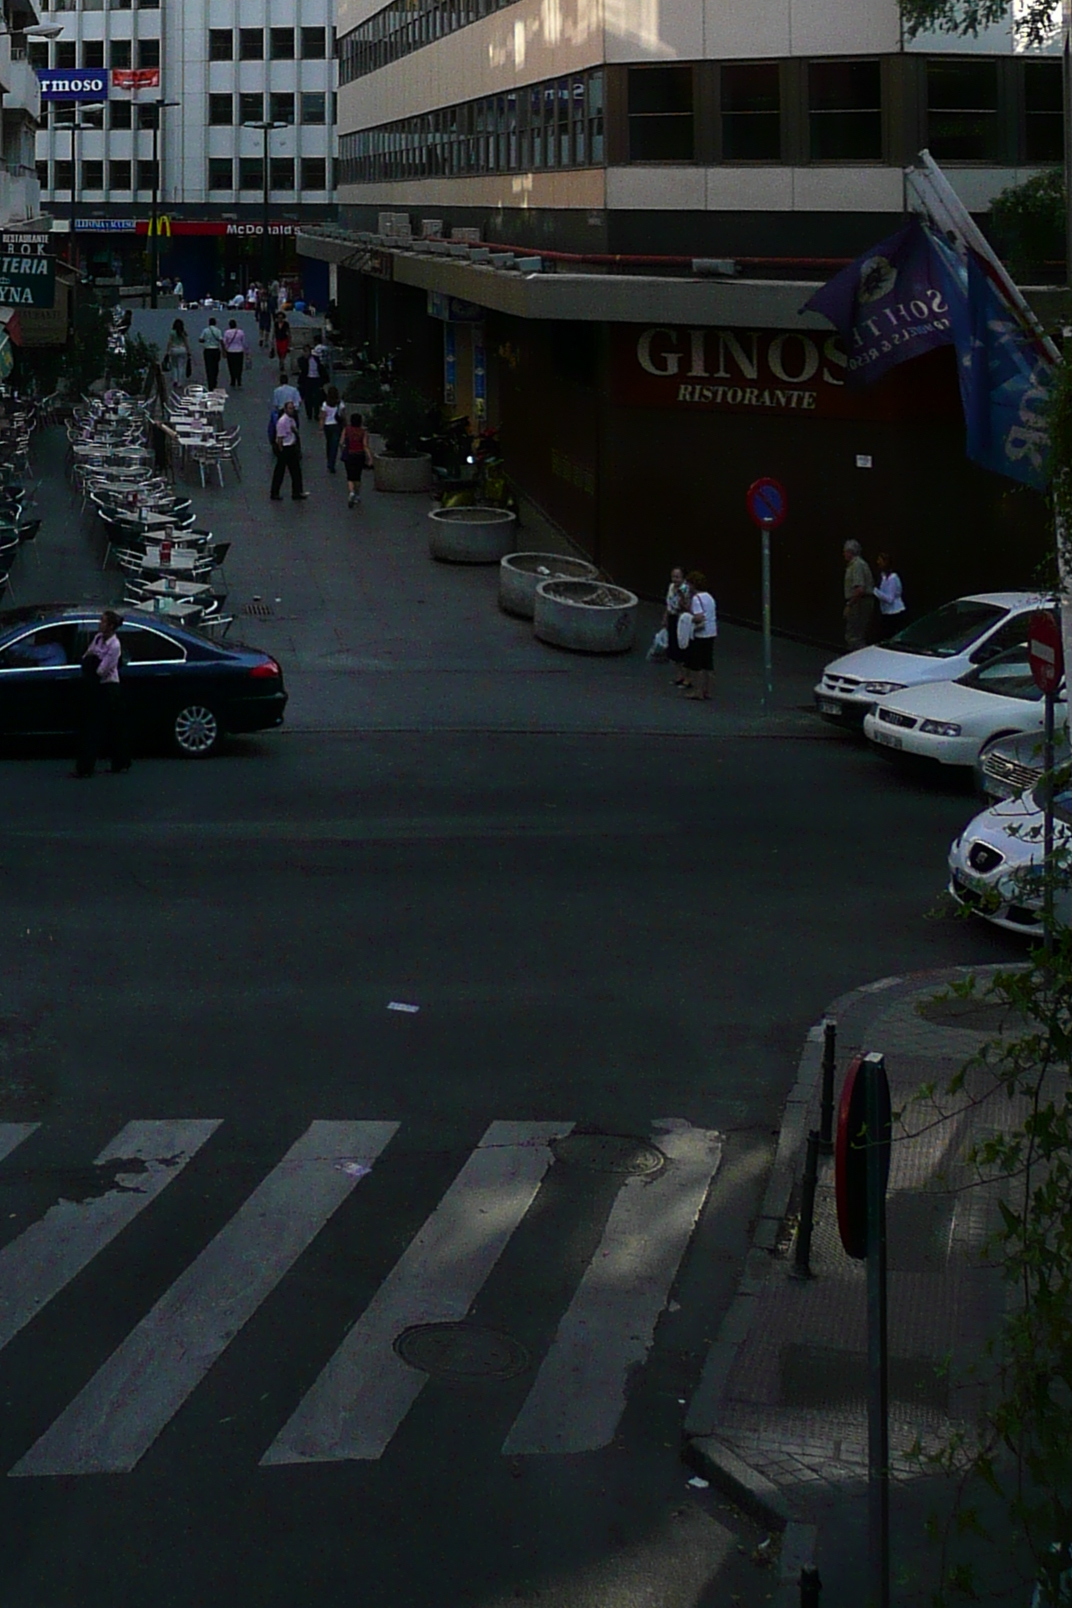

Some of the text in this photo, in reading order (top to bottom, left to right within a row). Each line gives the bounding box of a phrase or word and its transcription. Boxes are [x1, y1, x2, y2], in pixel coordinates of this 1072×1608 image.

[41, 79, 103, 92] rmoso
[636, 327, 848, 386] GINOS
[677, 383, 817, 410] RISTORANTE
